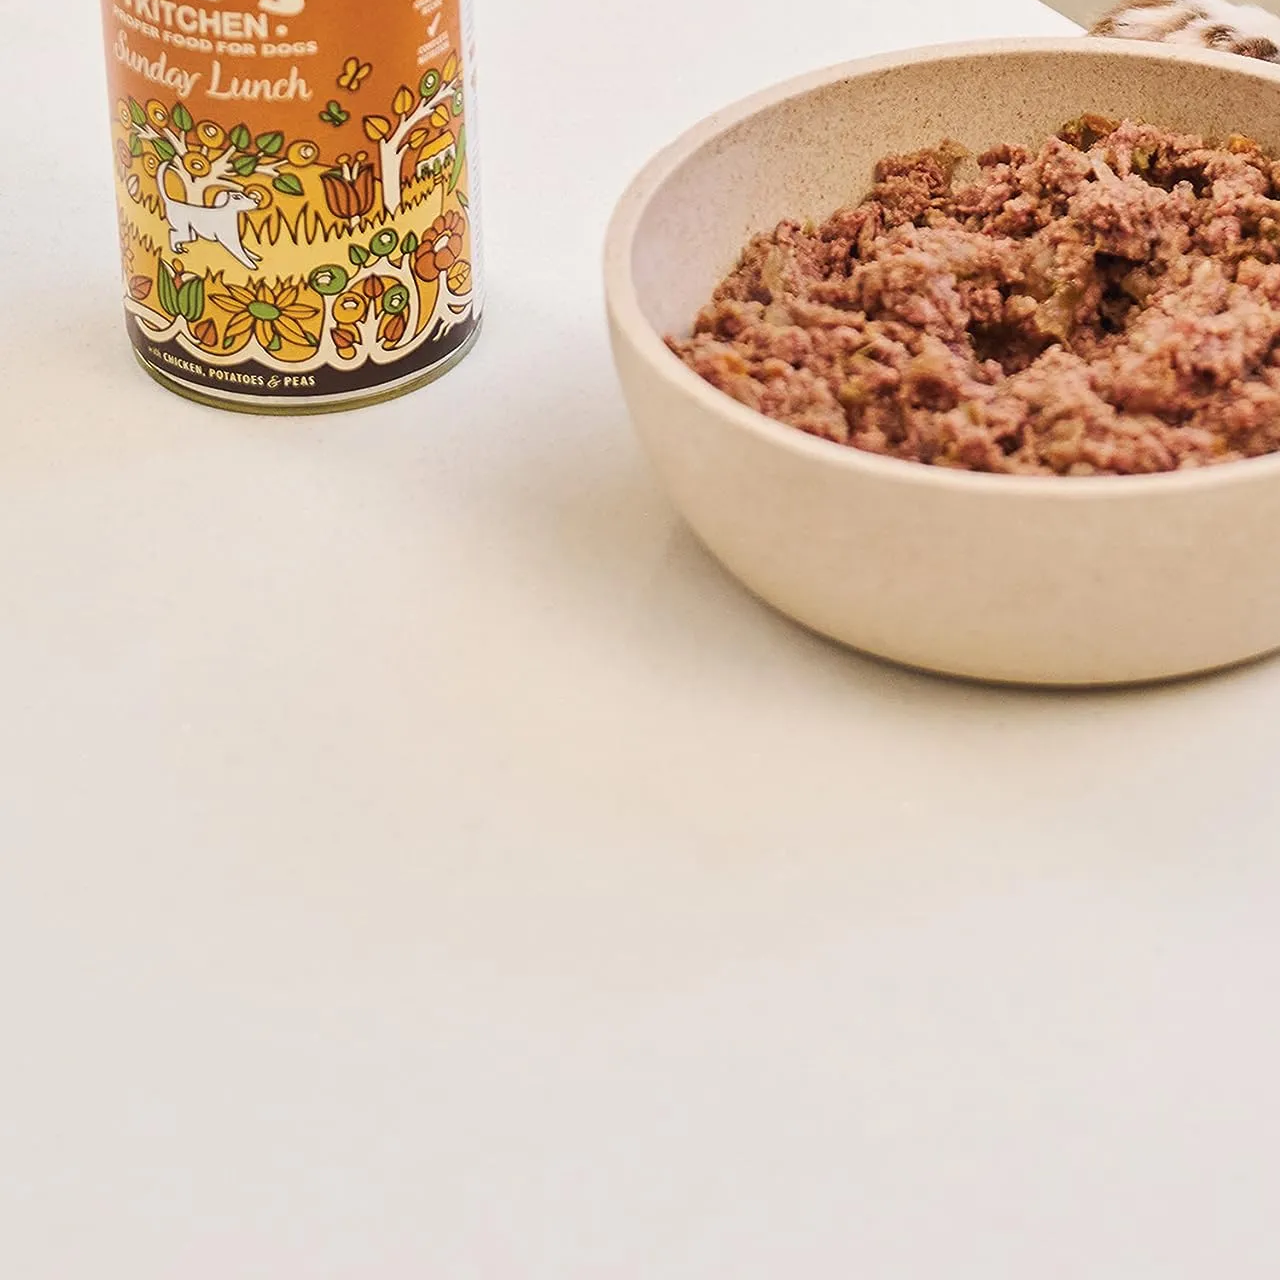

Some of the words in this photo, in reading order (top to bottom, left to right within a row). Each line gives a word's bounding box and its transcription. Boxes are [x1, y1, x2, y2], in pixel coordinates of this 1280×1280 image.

[162, 30, 214, 53] FOOD
[215, 41, 256, 57] FOR
[260, 40, 318, 58] DOGS
[113, 28, 202, 99] Sunday
[205, 60, 314, 101] Lunch
[209, 368, 264, 387] POTATOES
[266, 375, 281, 389] &
[284, 375, 316, 387] PEAS
